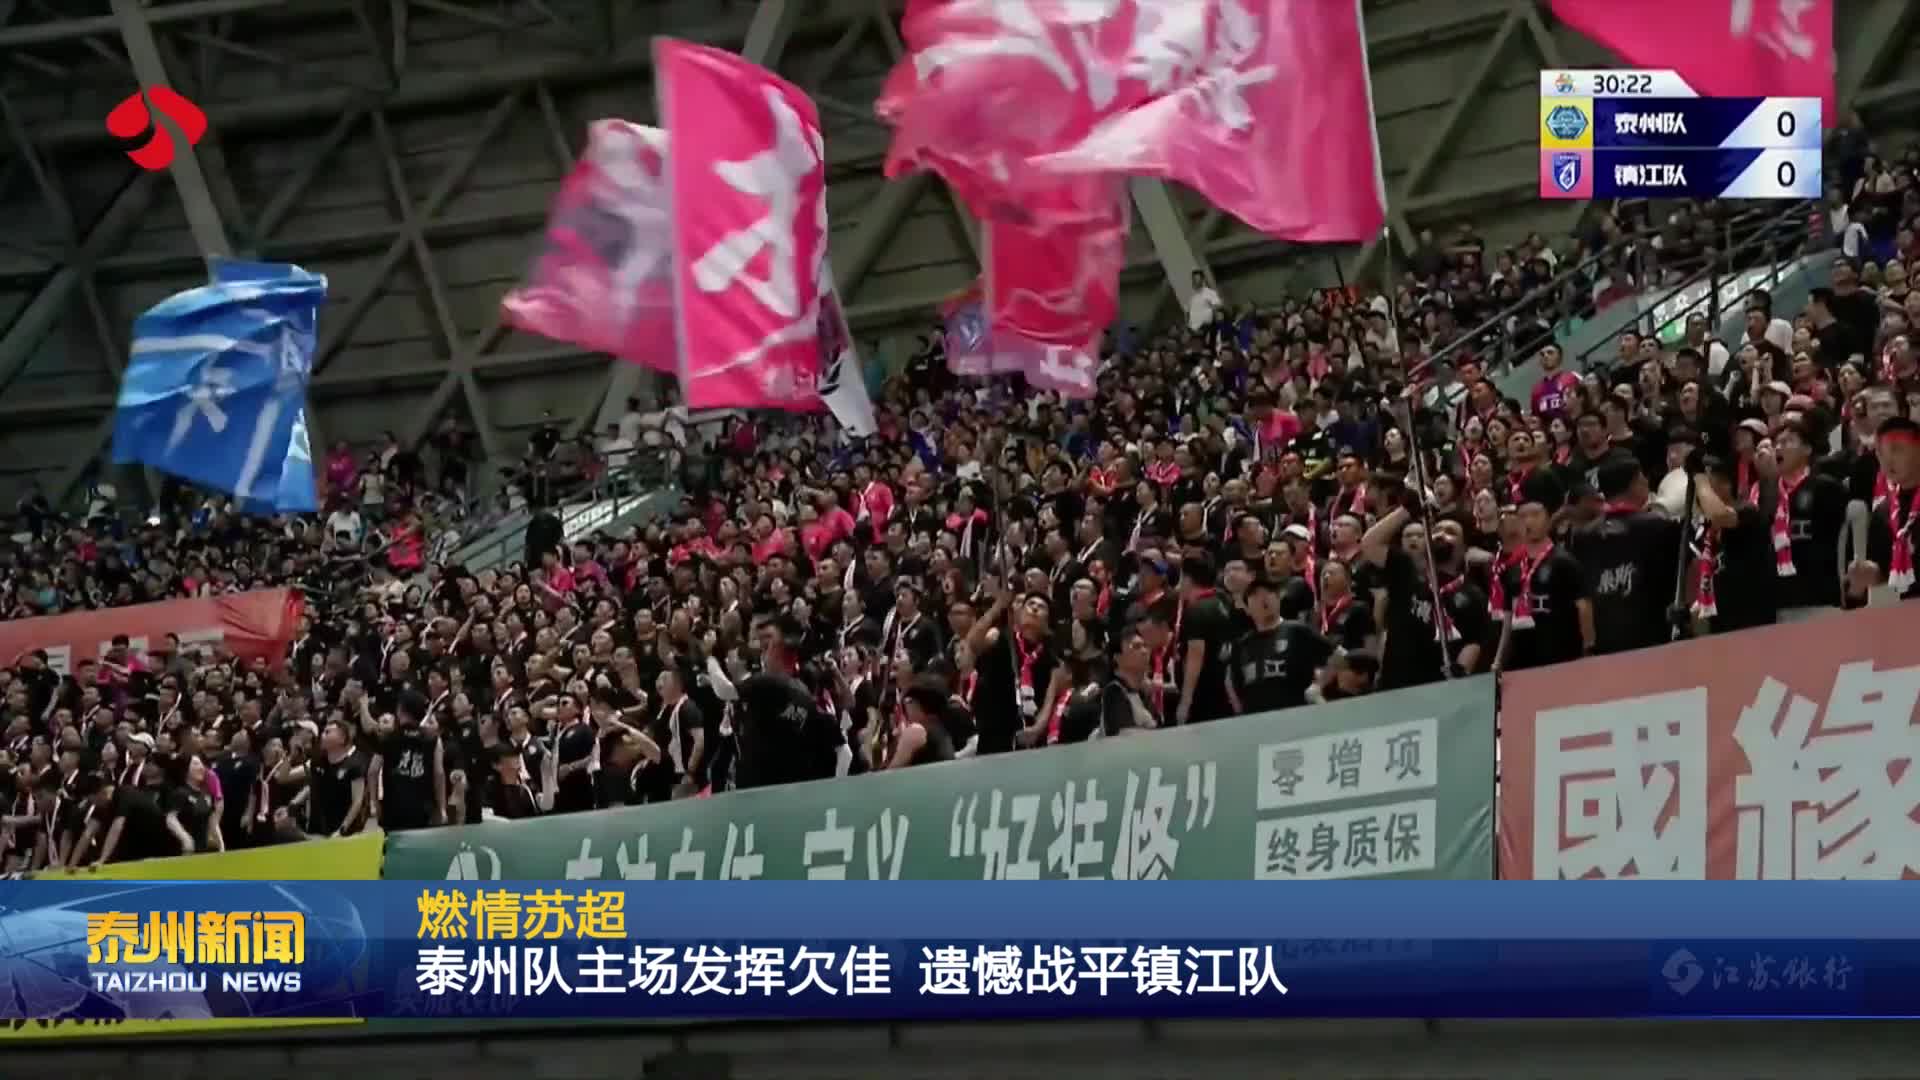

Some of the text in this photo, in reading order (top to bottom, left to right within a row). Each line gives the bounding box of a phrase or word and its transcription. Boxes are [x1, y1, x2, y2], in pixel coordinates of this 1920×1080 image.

[1272, 729, 1422, 796] 零增项
[1266, 812, 1421, 875] 终身质保
